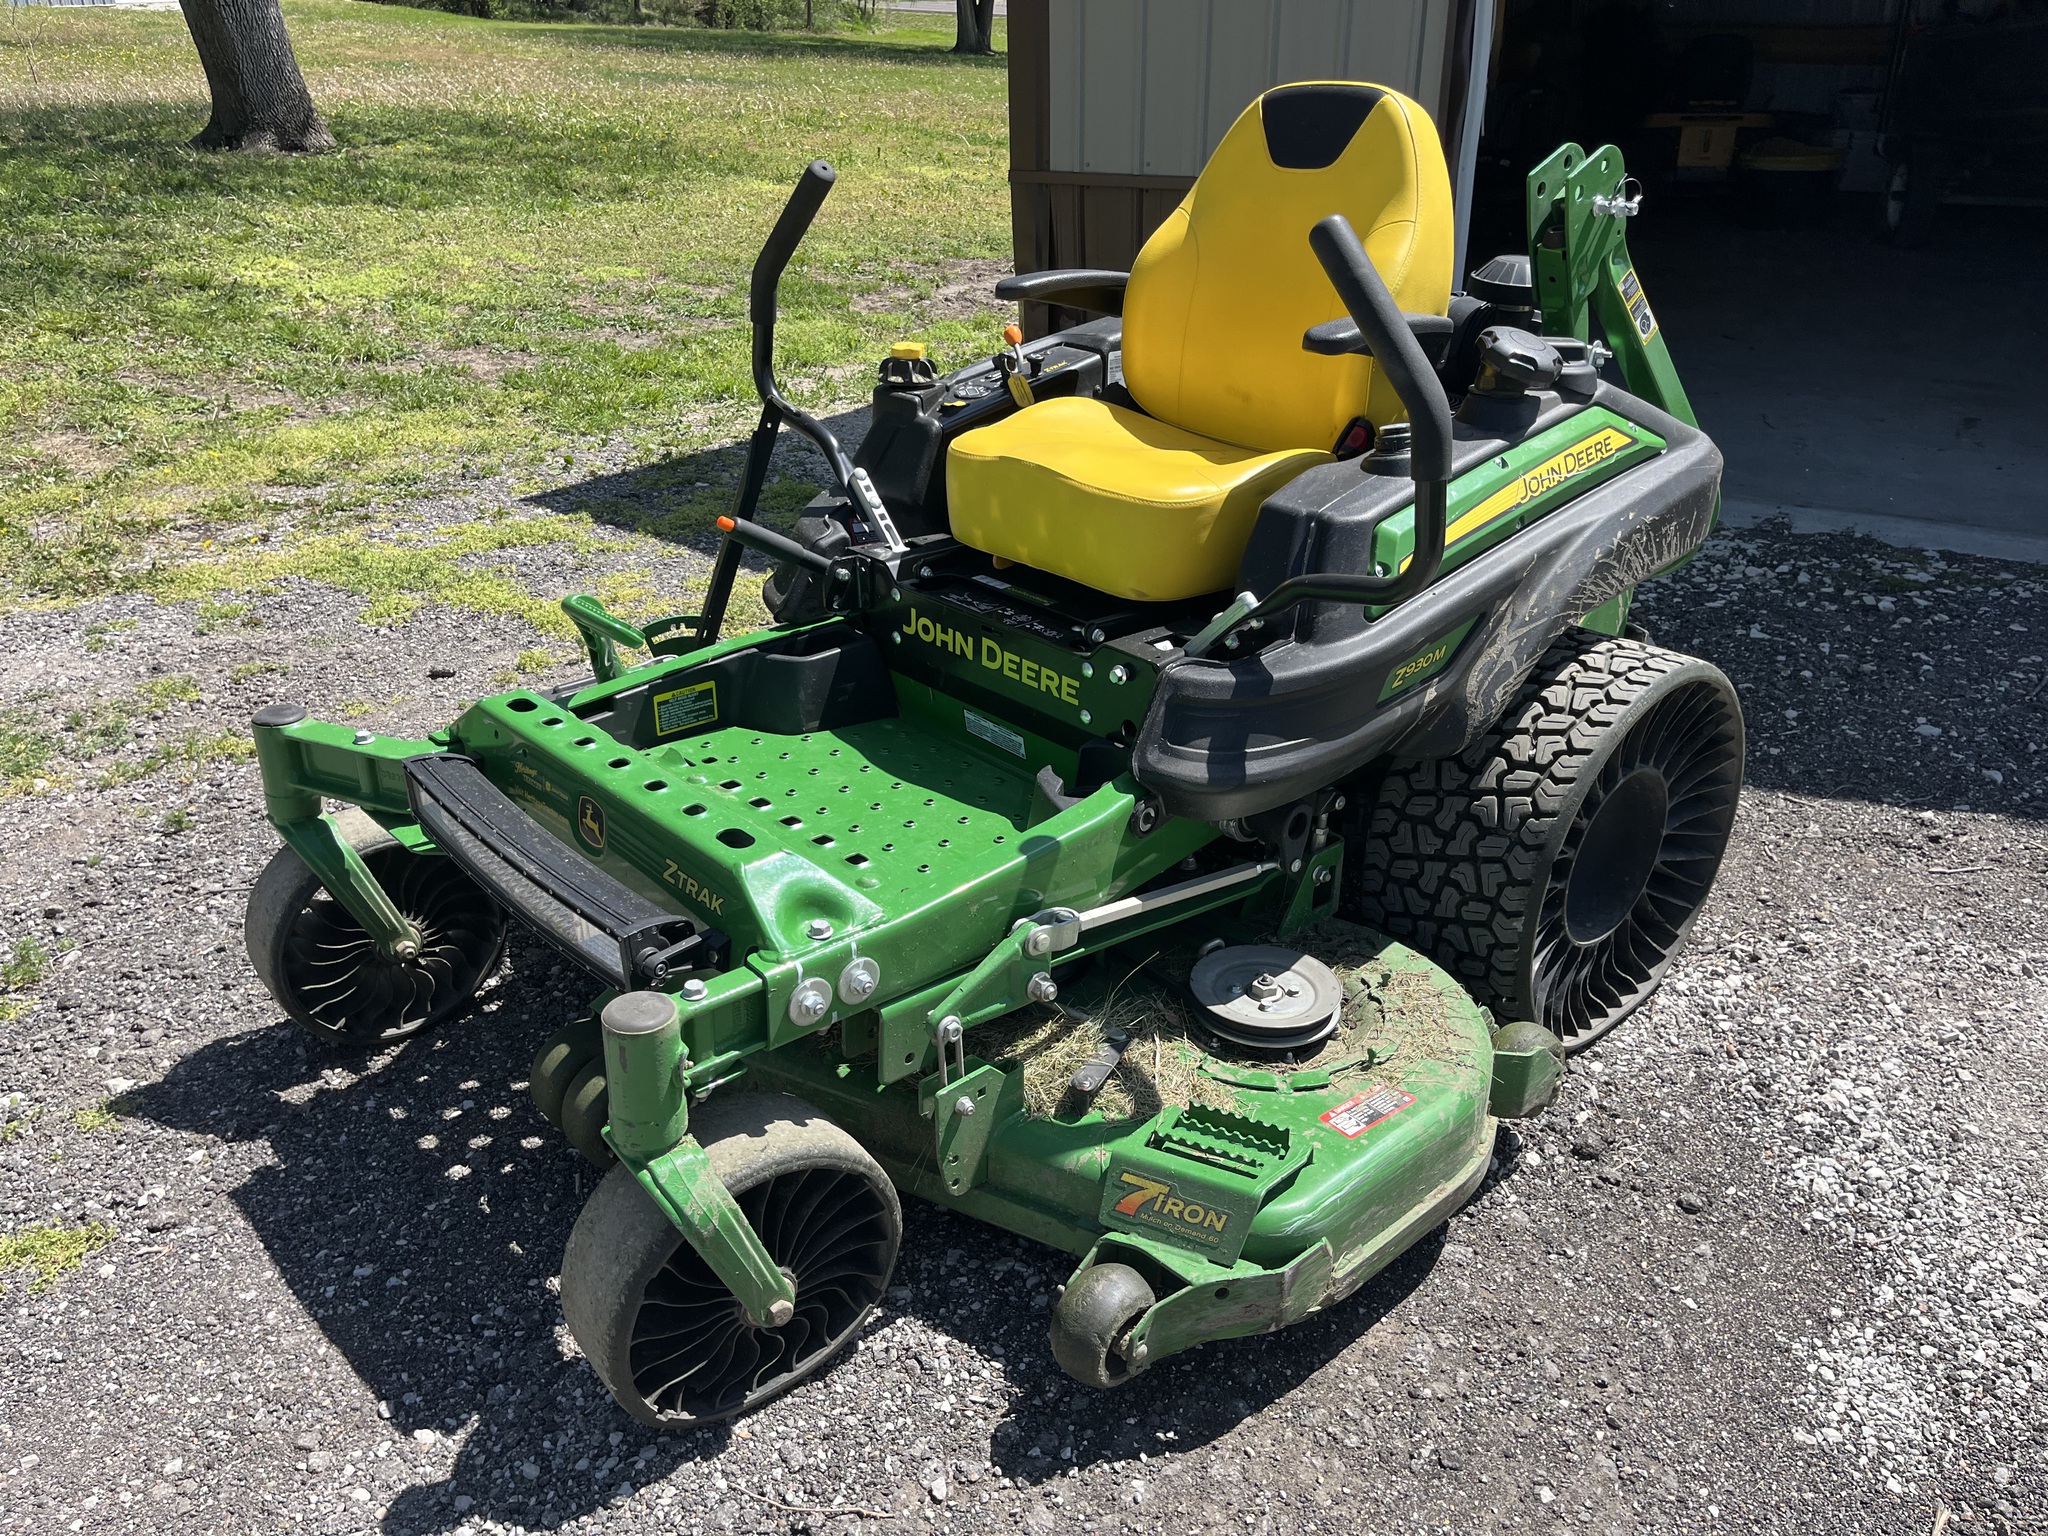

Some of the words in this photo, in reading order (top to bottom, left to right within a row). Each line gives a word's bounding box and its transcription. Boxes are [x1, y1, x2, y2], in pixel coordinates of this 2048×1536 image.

[1519, 461, 1563, 500] JOHN
[1565, 435, 1614, 474] DEERE
[902, 607, 973, 661] JOHN
[981, 637, 1080, 706] DEERE
[1391, 645, 1448, 690] Z930M
[662, 858, 725, 917] ZTRAK
[1140, 1212, 1162, 1226] Mulch
[1163, 1221, 1173, 1230] on
[1174, 1224, 1207, 1240] Demand
[1208, 1235, 1220, 1244] 60
